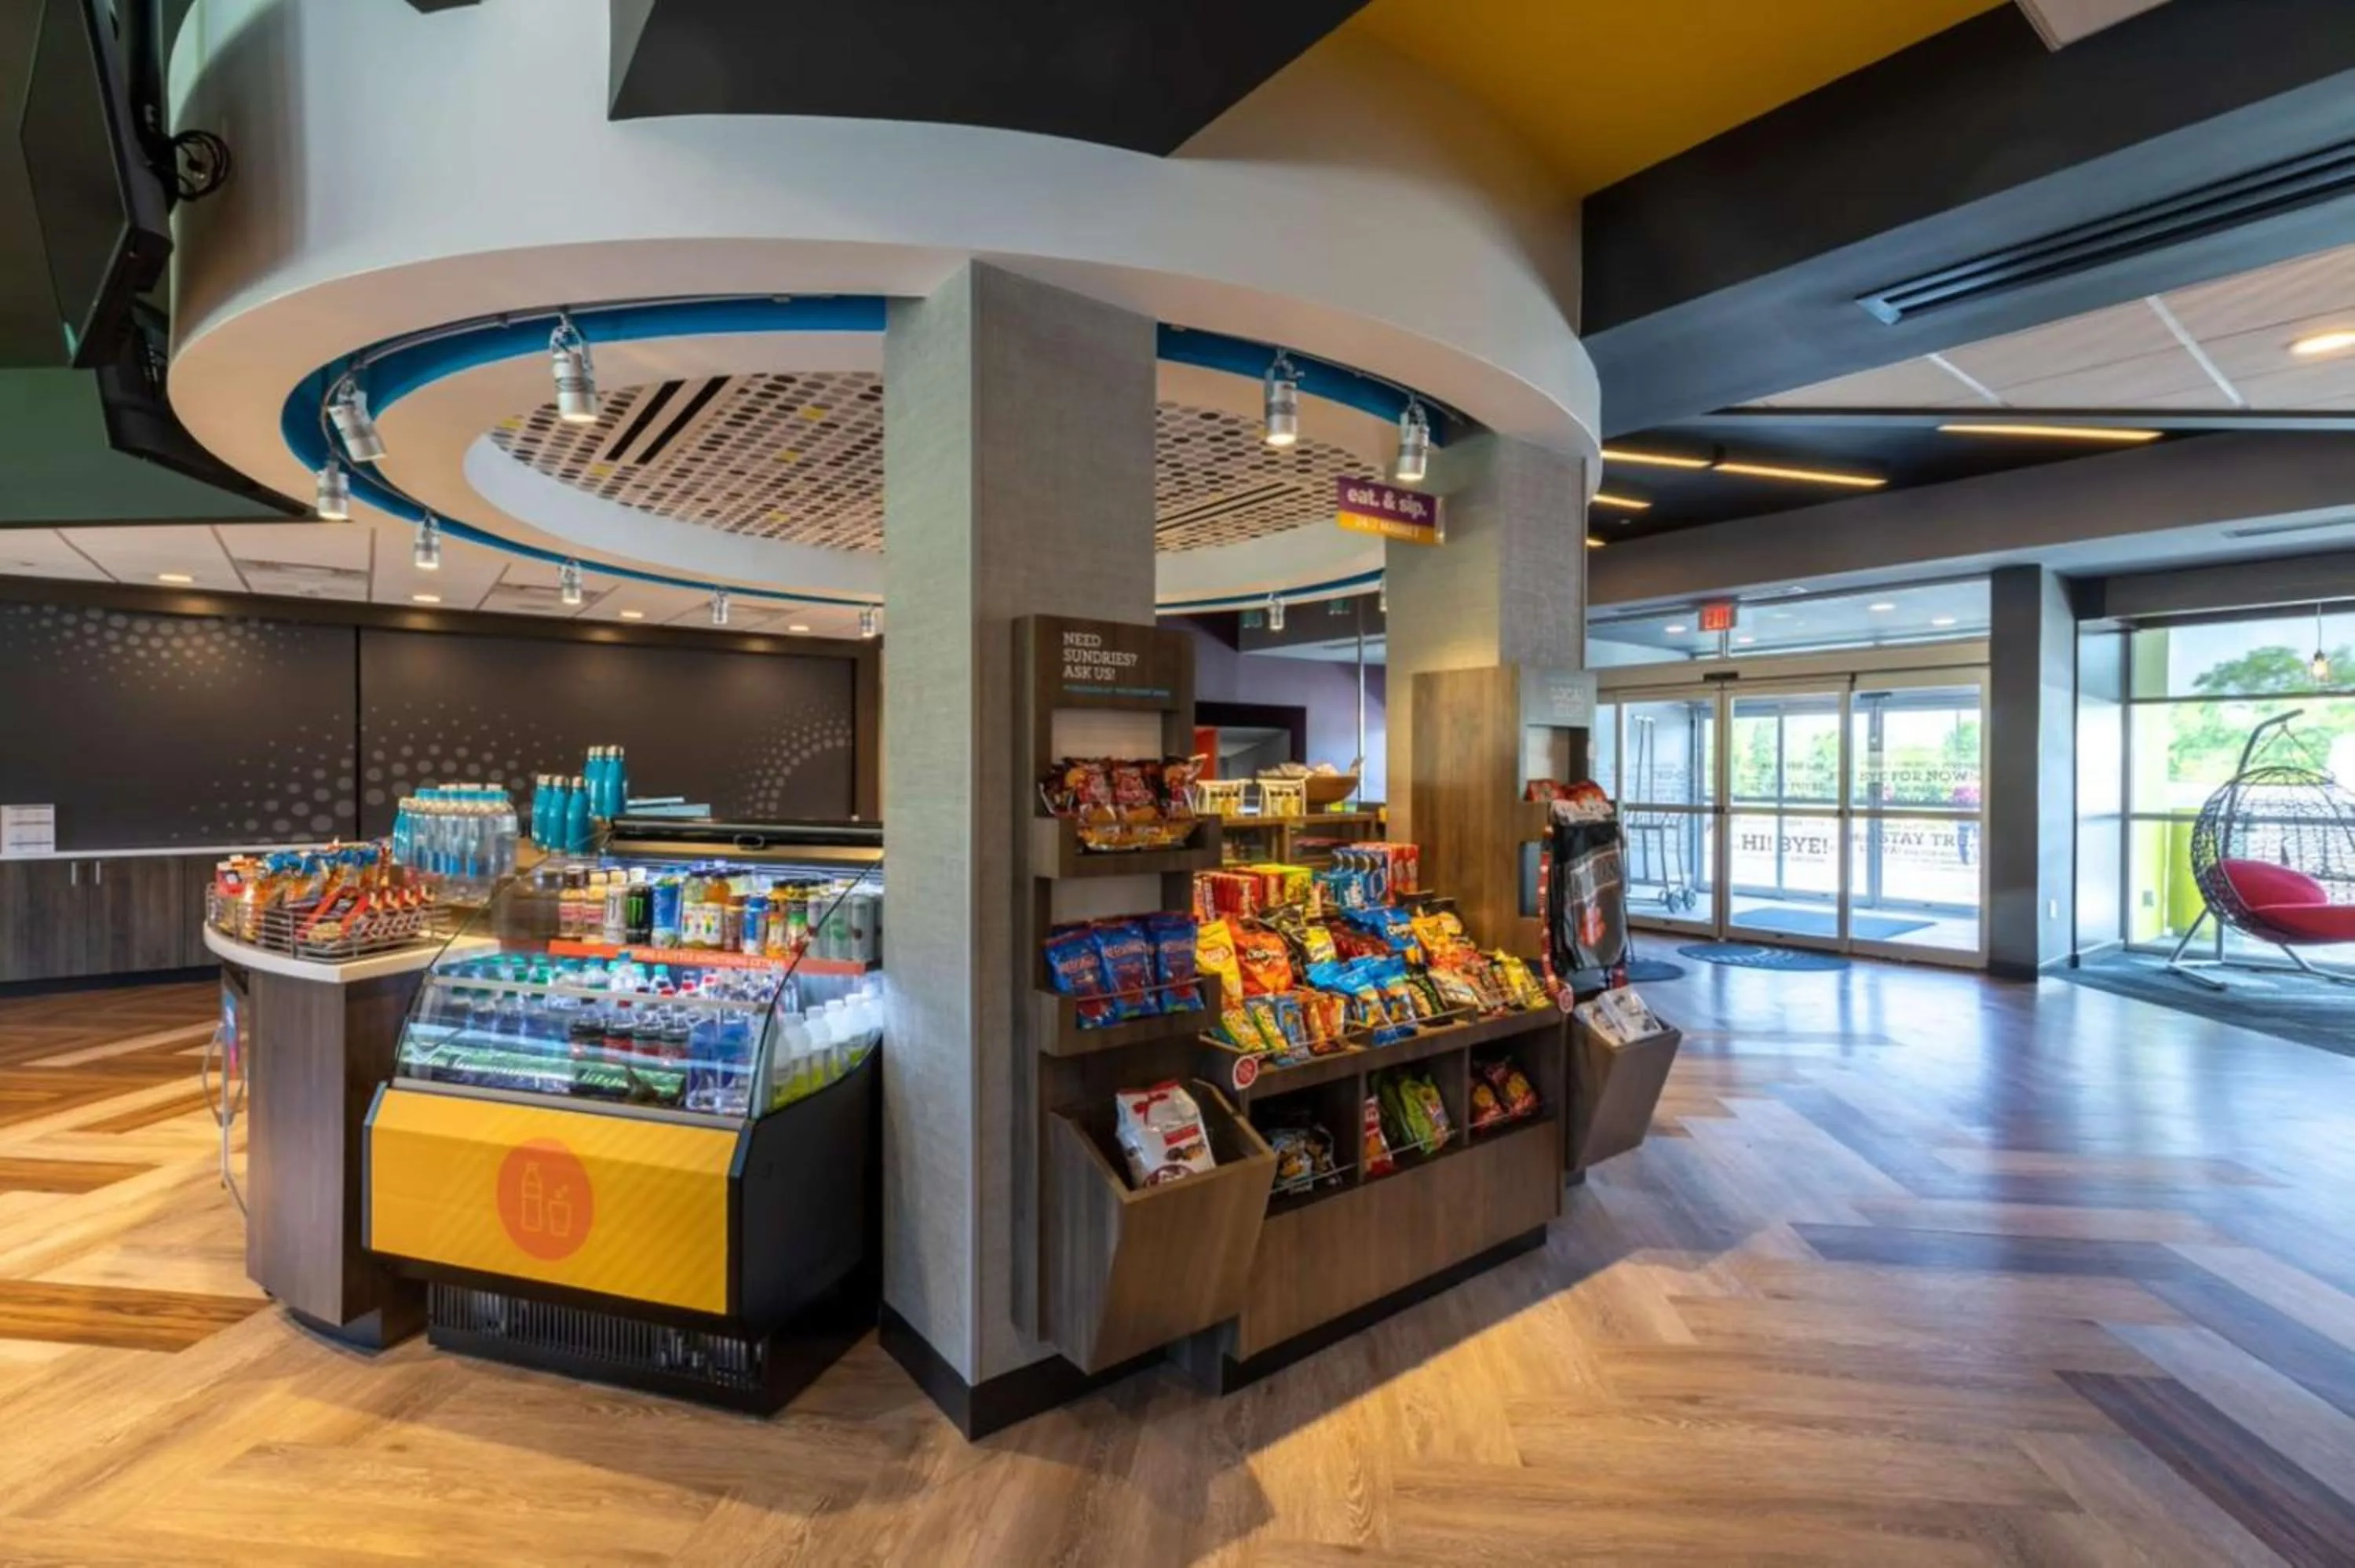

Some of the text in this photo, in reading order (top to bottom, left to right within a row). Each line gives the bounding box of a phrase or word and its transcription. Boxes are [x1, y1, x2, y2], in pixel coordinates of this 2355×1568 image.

[1346, 487, 1427, 520] eat. & sip.
[1063, 631, 1102, 647] NEED
[1063, 647, 1138, 666] SUNDRIES?
[1063, 665, 1116, 680] ASK US!
[1741, 833, 1828, 855] HI! BYE!
